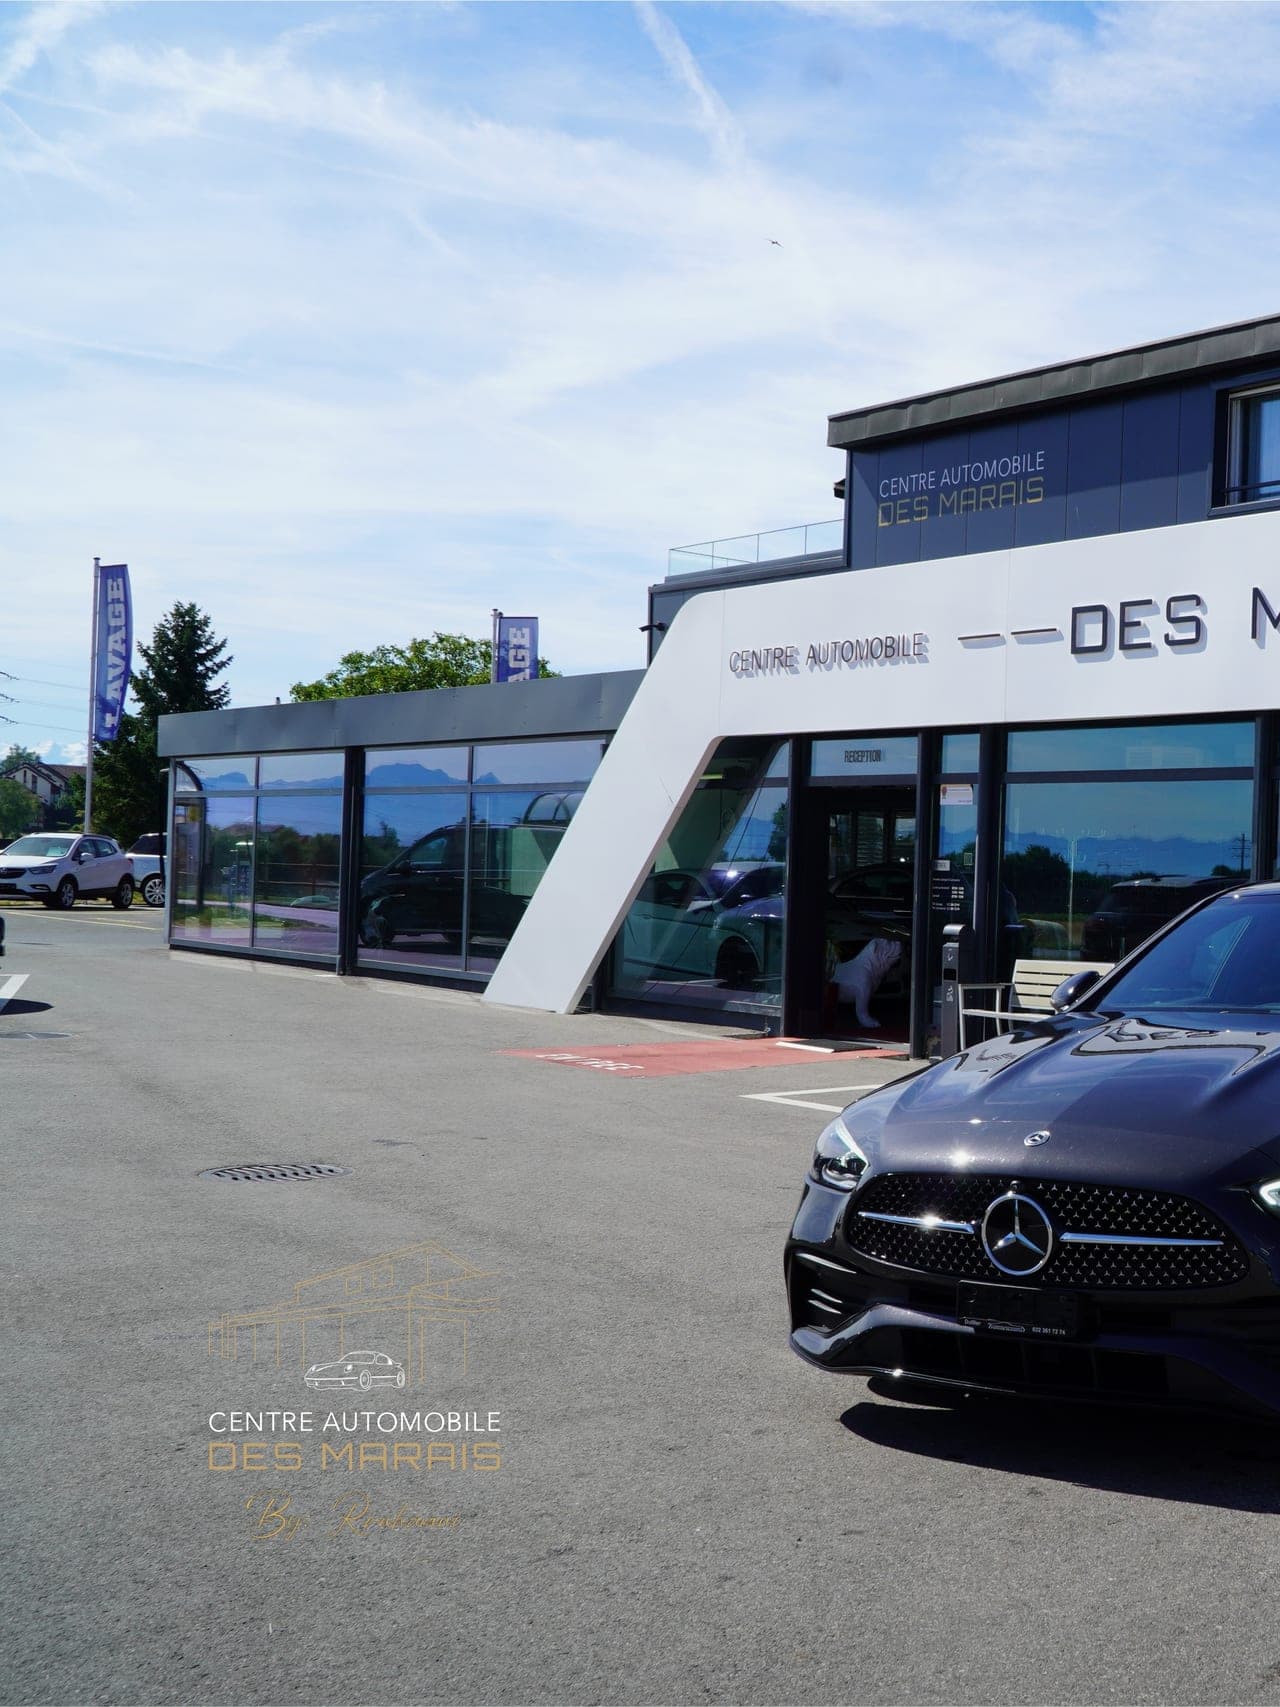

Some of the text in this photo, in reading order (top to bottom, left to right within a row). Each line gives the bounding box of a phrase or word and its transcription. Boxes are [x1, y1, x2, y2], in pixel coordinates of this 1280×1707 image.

[879, 450, 1045, 498] CENTRE AUTOMOBILE
[877, 476, 1044, 527] DES MARAIS
[1070, 594, 1202, 655] DES
[104, 577, 127, 729] LAVAGE
[729, 632, 925, 673] CENTRE AUTOMOBILE
